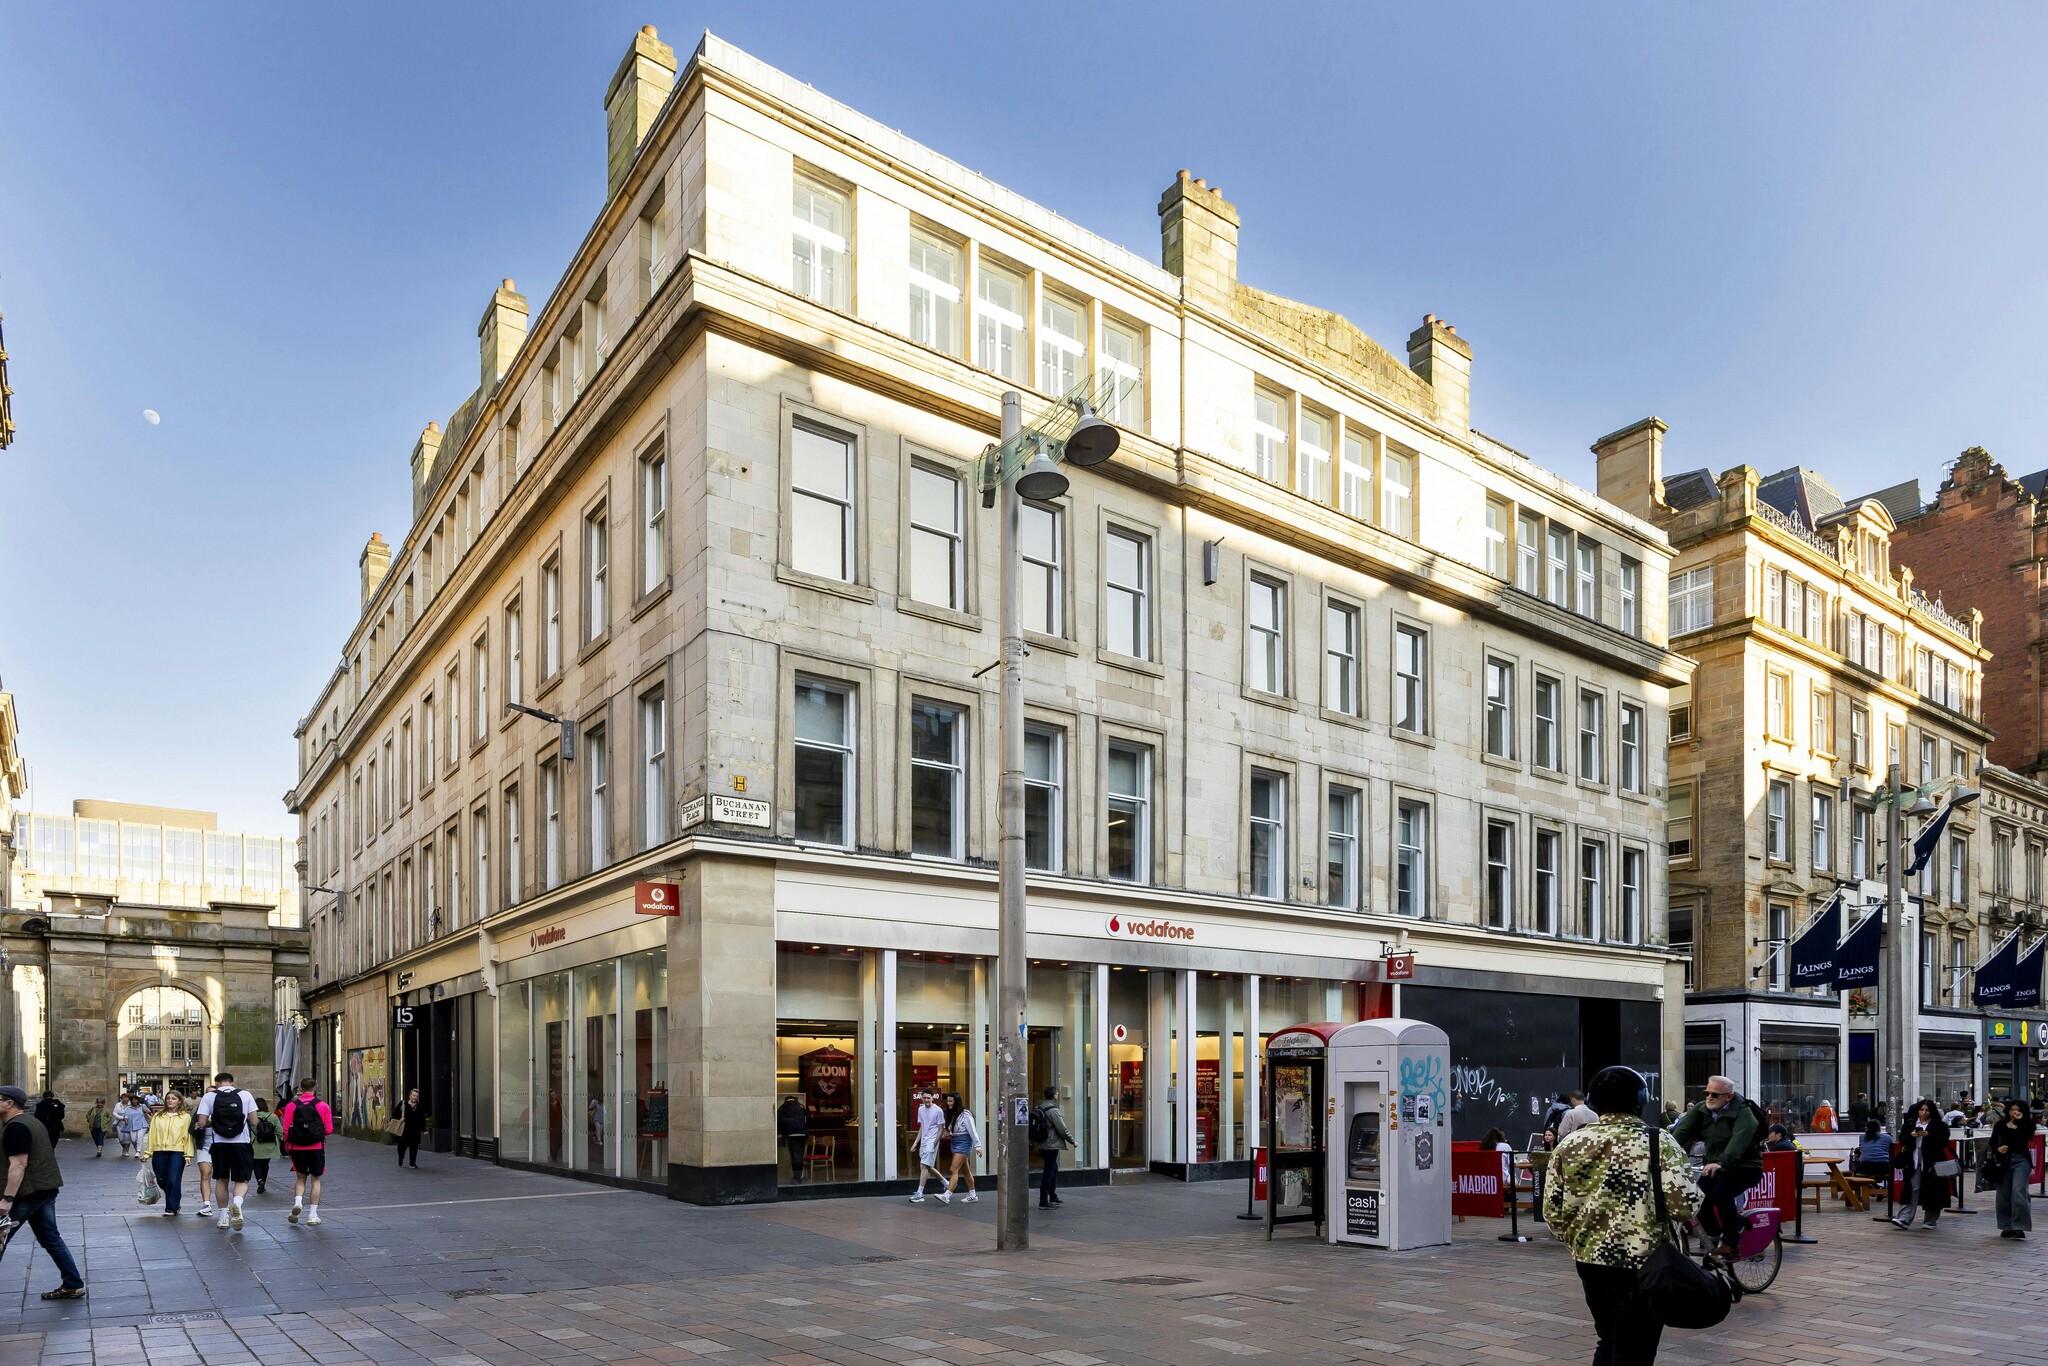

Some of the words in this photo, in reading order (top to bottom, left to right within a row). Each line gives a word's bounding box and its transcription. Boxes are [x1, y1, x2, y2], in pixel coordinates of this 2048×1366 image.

[735, 777, 745, 790] H
[715, 797, 767, 812] BUCHANAN
[686, 810, 700, 822] PLACE
[723, 807, 760, 820] STREET
[642, 902, 675, 911] vodafone
[536, 926, 566, 947] vodafone
[1127, 920, 1195, 940] vodafone
[1796, 960, 1833, 976] LAINGS
[1838, 965, 1874, 979] LAINGS
[1979, 983, 2011, 996] LAINGS
[2014, 988, 2037, 997] INGS
[396, 1007, 414, 1023] 15
[812, 1063, 846, 1077] ZOOM
[1459, 1175, 1498, 1195] MADRID
[1348, 1195, 1377, 1209] cash
